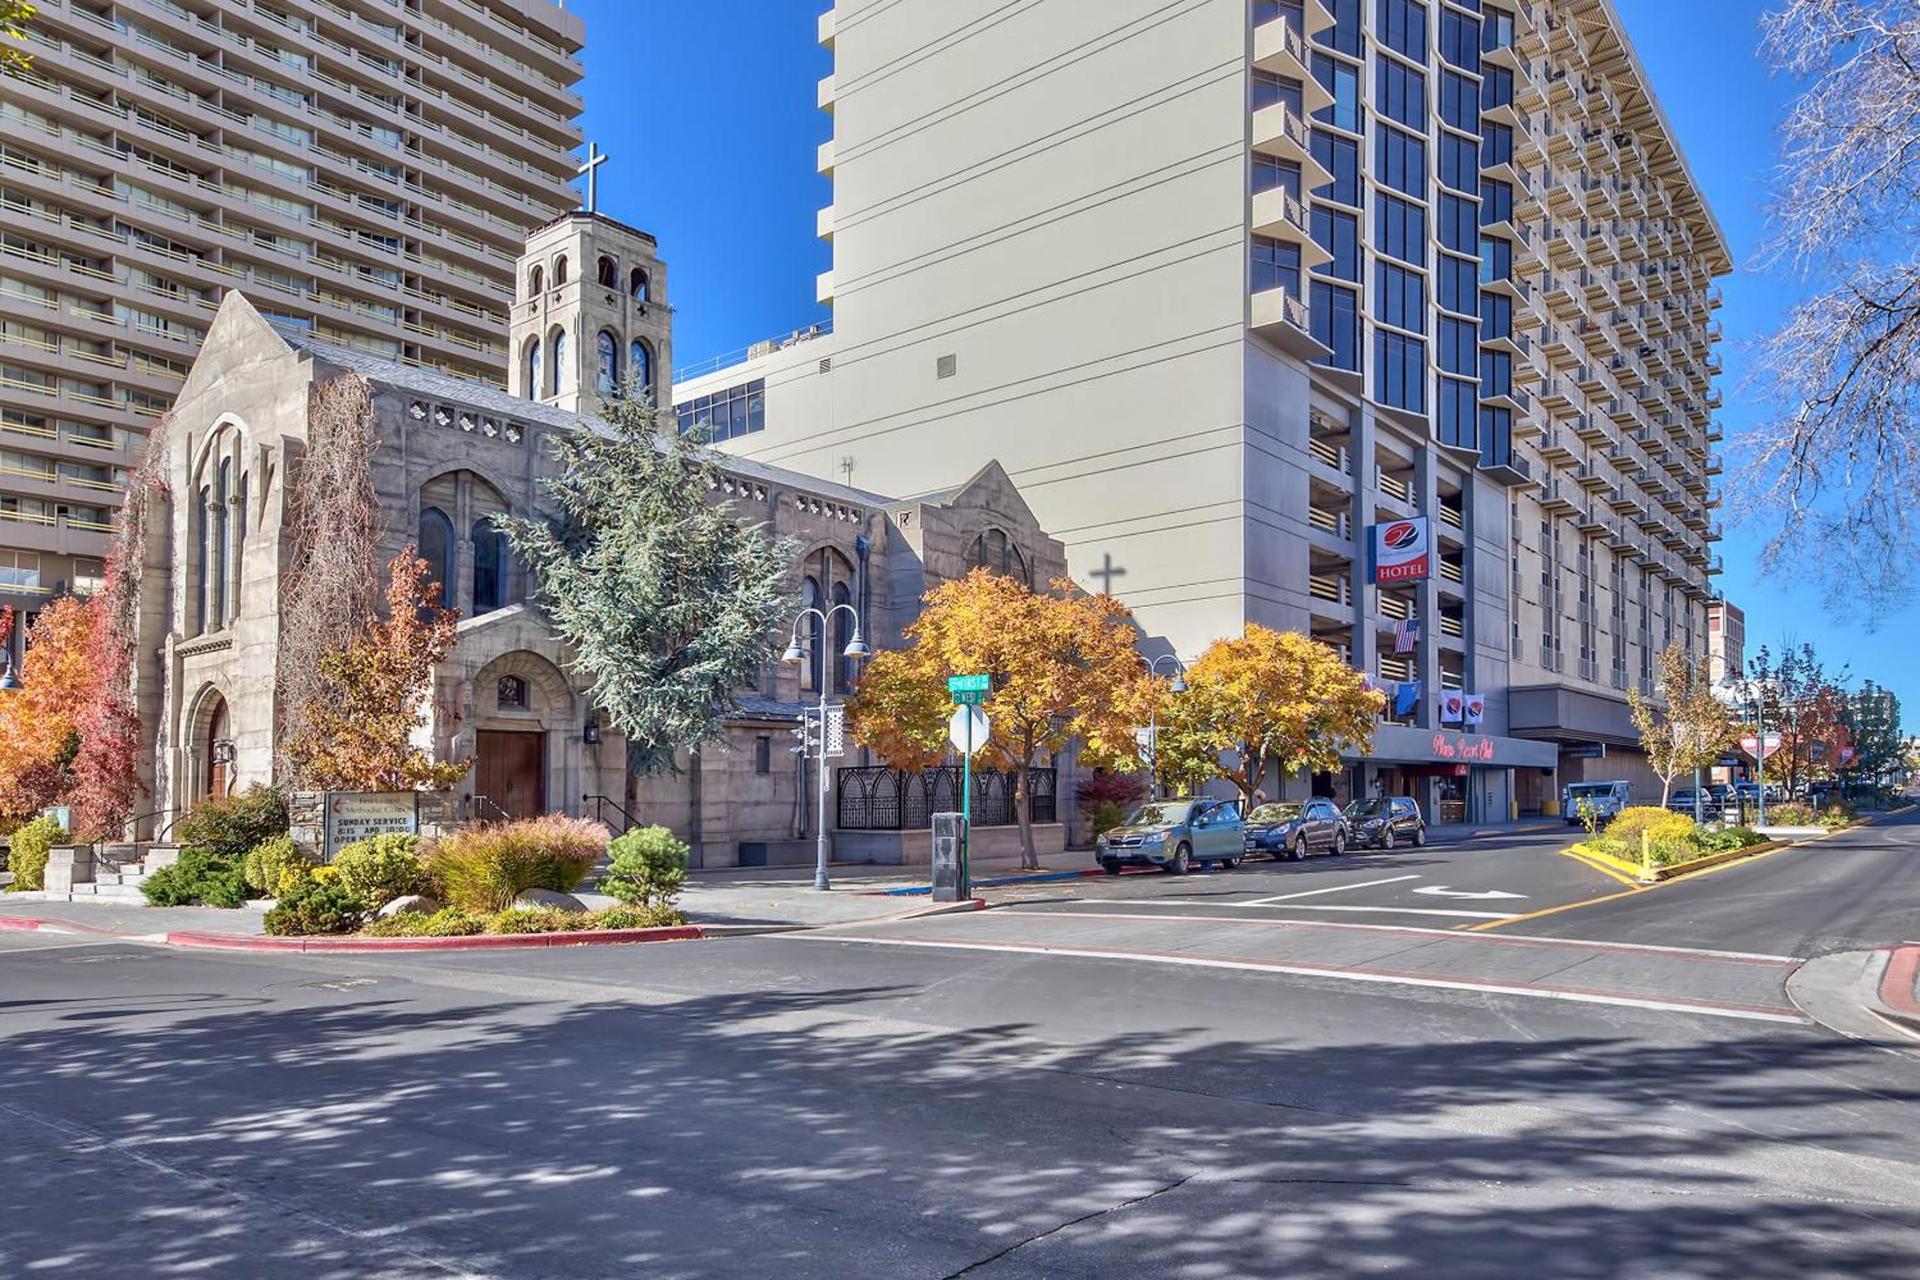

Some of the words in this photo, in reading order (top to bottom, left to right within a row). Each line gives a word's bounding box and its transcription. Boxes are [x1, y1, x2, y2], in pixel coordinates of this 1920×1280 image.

[1380, 564, 1424, 578] HOTEL
[338, 818, 370, 826] SUNDAY
[373, 817, 408, 825] SERVICE
[364, 826, 380, 834] AND
